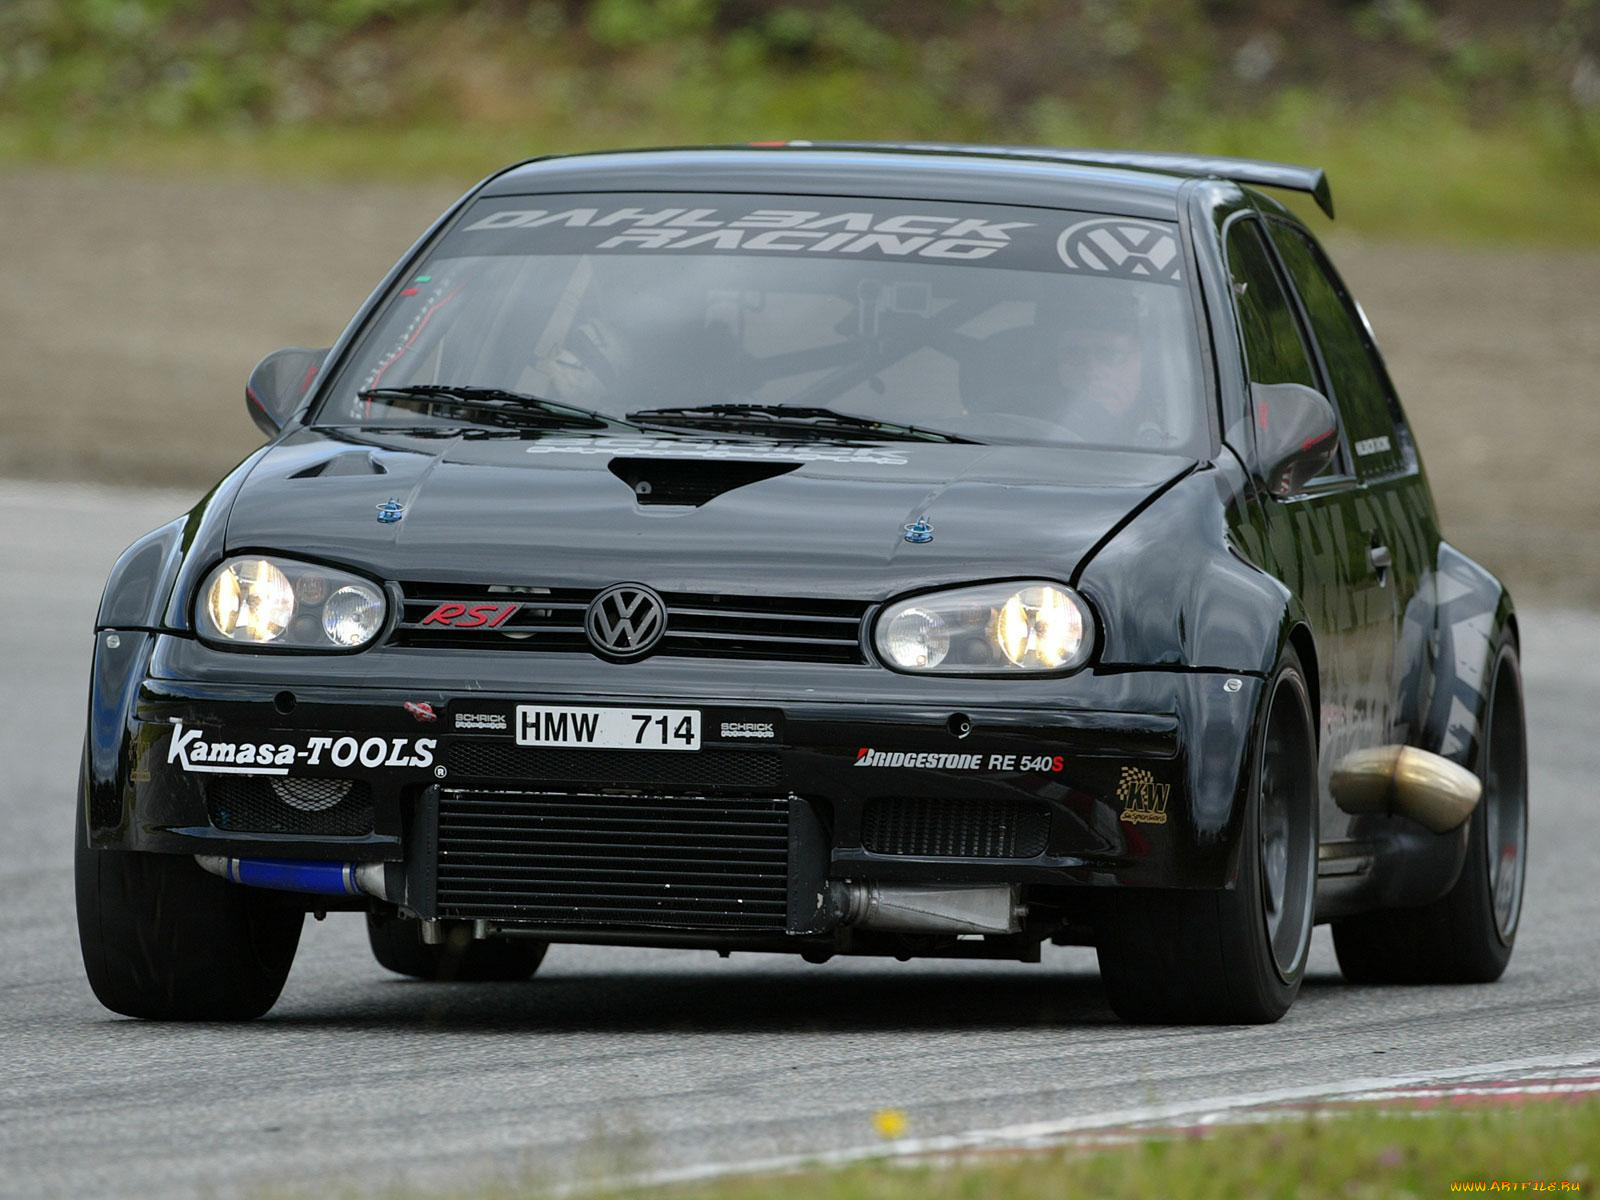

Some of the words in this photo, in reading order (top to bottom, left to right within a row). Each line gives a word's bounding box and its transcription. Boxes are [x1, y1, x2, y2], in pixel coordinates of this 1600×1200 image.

[463, 206, 1037, 240] DAHLBACK
[596, 225, 1017, 259] RACING
[455, 713, 506, 722] SCHRICK
[520, 708, 599, 743] HMW
[632, 713, 695, 747] 714
[720, 722, 774, 731] SCHRICK
[167, 717, 437, 775] Kamasa-TOOLS
[853, 747, 982, 769] BRIDGESTONE
[988, 754, 1015, 769] RE
[1019, 755, 1064, 772] 540S
[1124, 781, 1171, 812] KW
